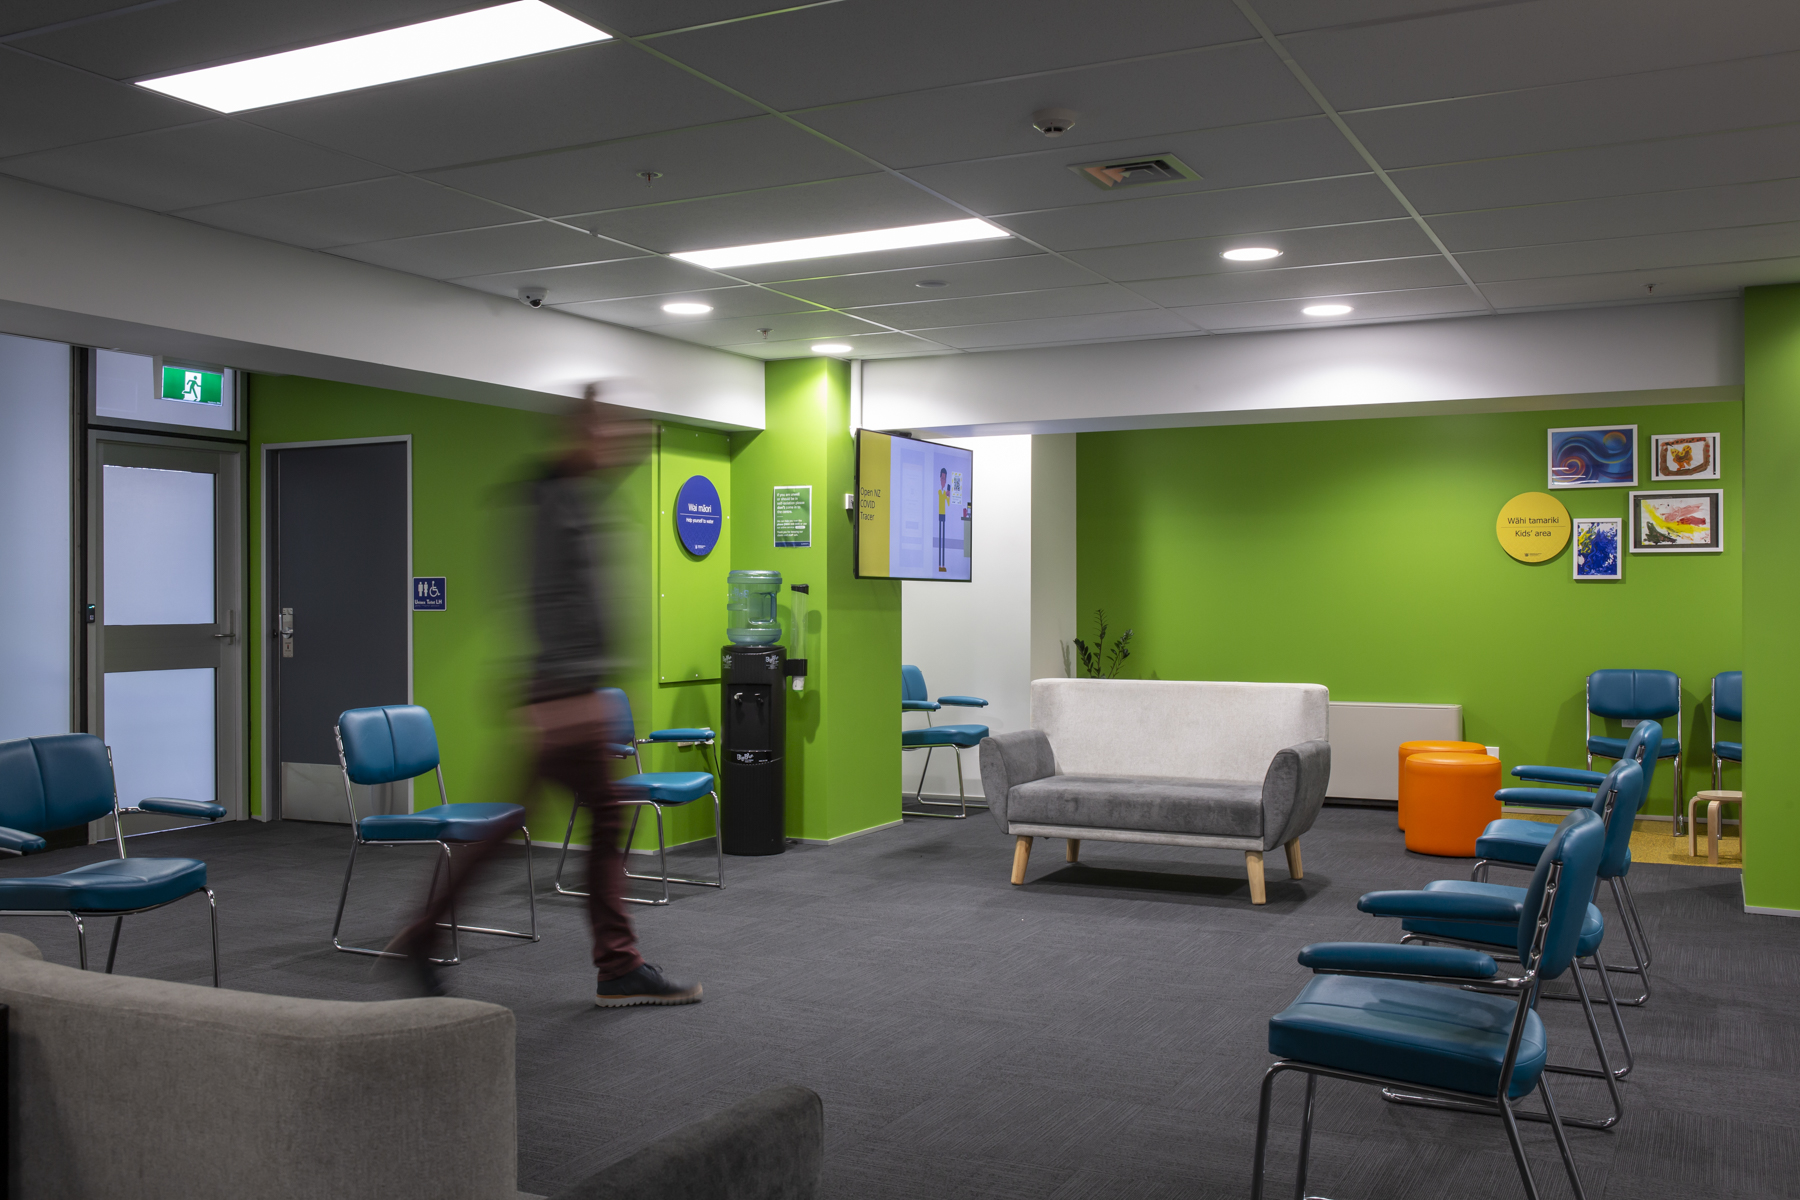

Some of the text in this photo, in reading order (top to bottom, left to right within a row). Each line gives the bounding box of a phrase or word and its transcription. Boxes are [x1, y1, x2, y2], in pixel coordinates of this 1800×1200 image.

[861, 487, 881, 497] Open NZ
[688, 503, 711, 512] Wai māori
[860, 499, 875, 508] COVID
[860, 511, 874, 520] Tracer
